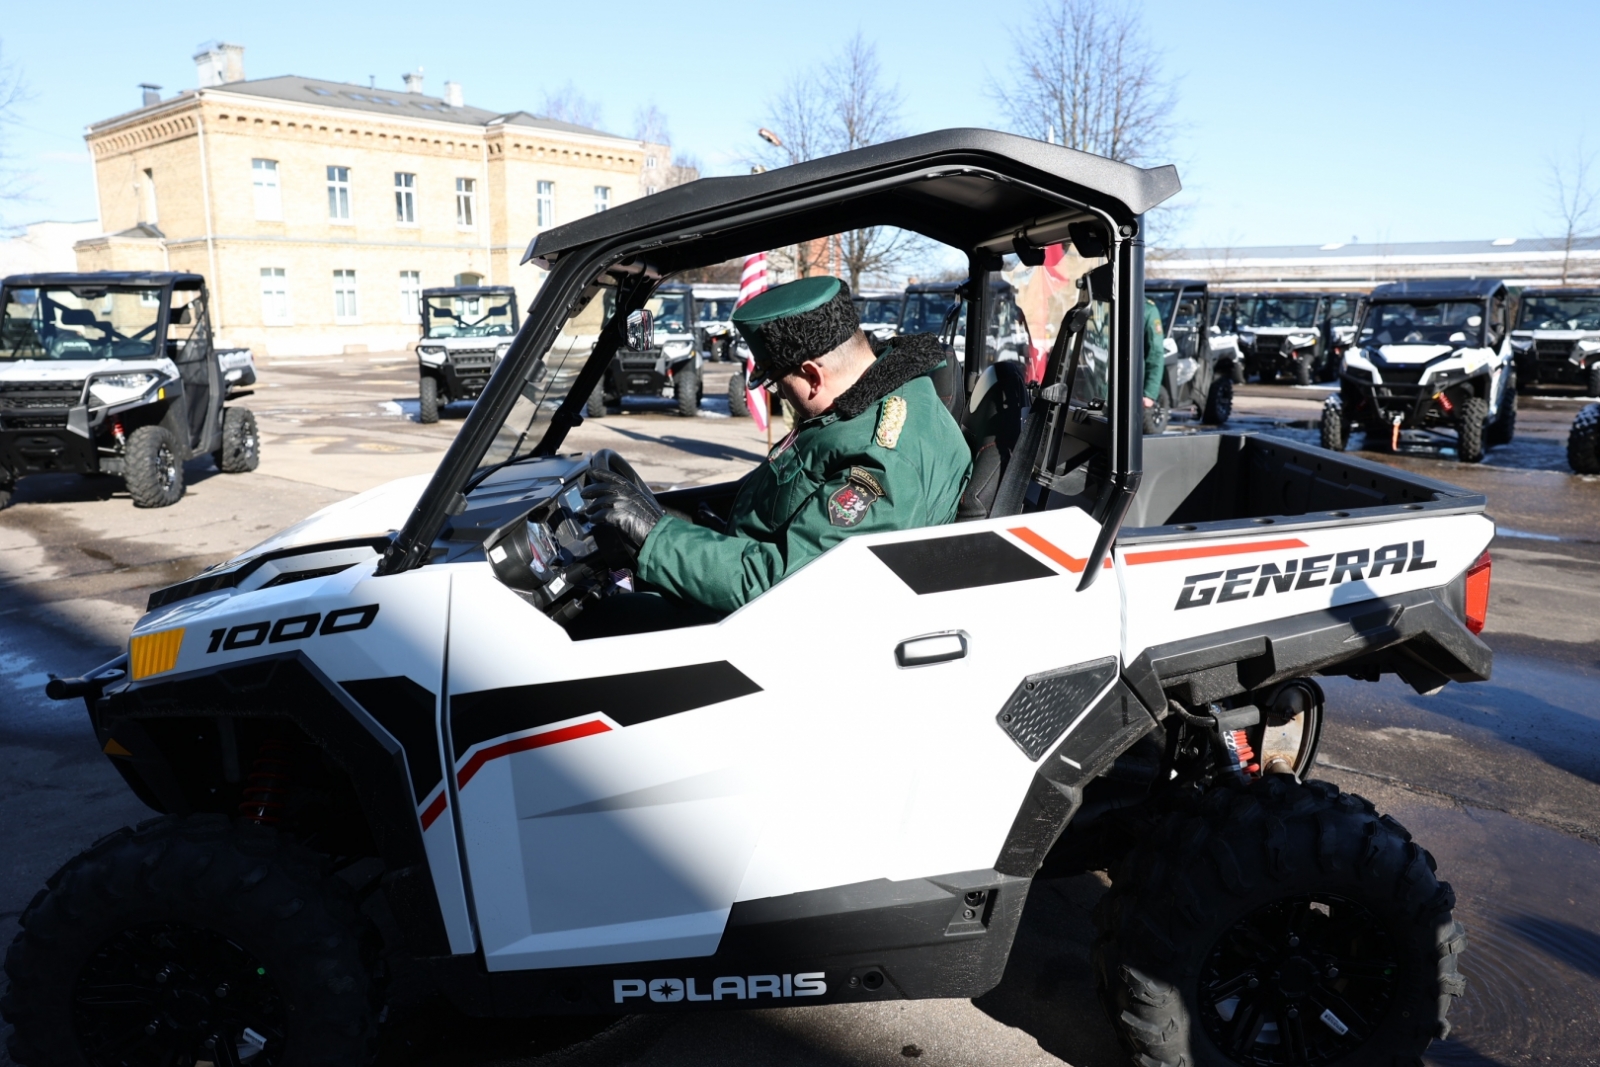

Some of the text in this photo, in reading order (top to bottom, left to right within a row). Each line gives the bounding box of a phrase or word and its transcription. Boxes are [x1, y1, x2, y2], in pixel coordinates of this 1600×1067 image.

[1174, 540, 1437, 611] GENERAL
[206, 603, 380, 654] 1000
[613, 972, 827, 1003] POLARIS
